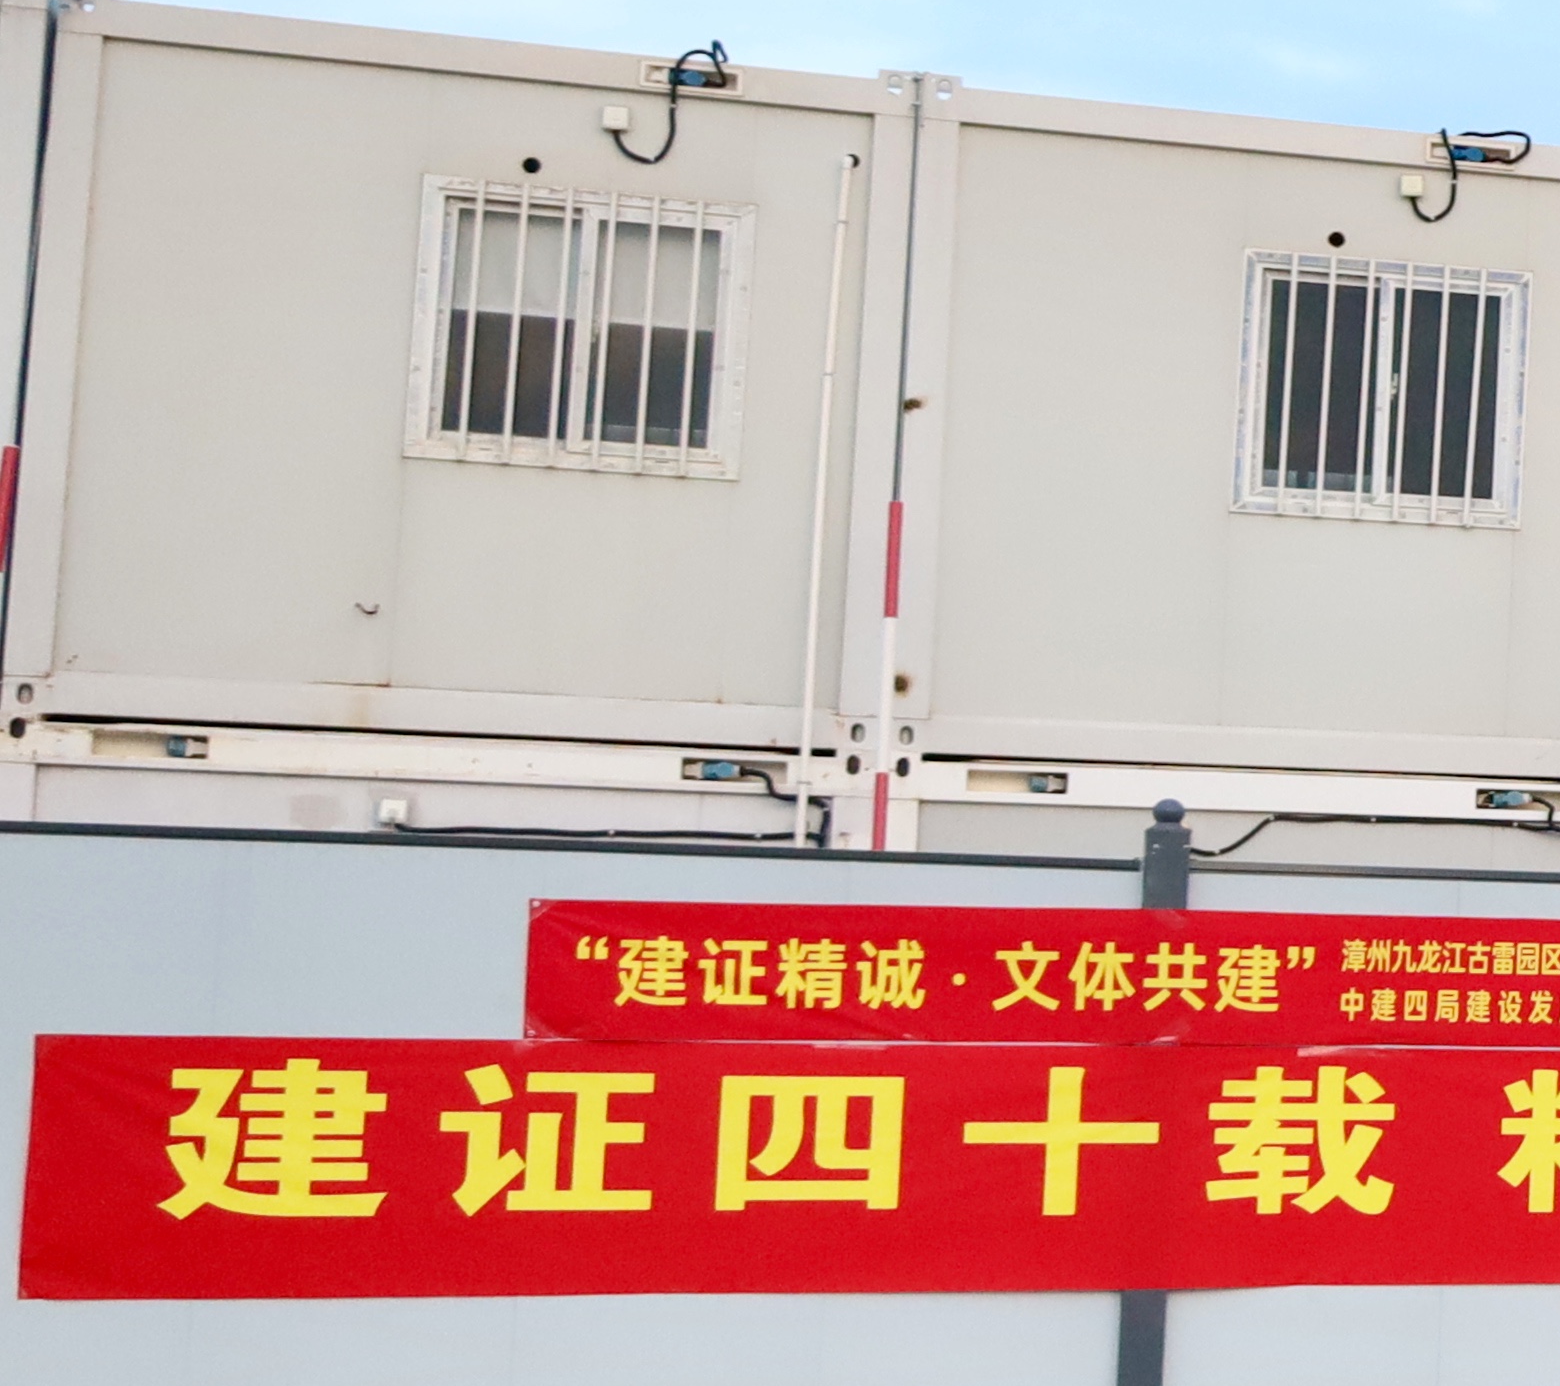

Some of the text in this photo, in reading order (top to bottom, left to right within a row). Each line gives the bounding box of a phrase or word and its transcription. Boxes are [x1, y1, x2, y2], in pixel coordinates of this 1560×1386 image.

[157, 1057, 1397, 1220] 建证四十载
